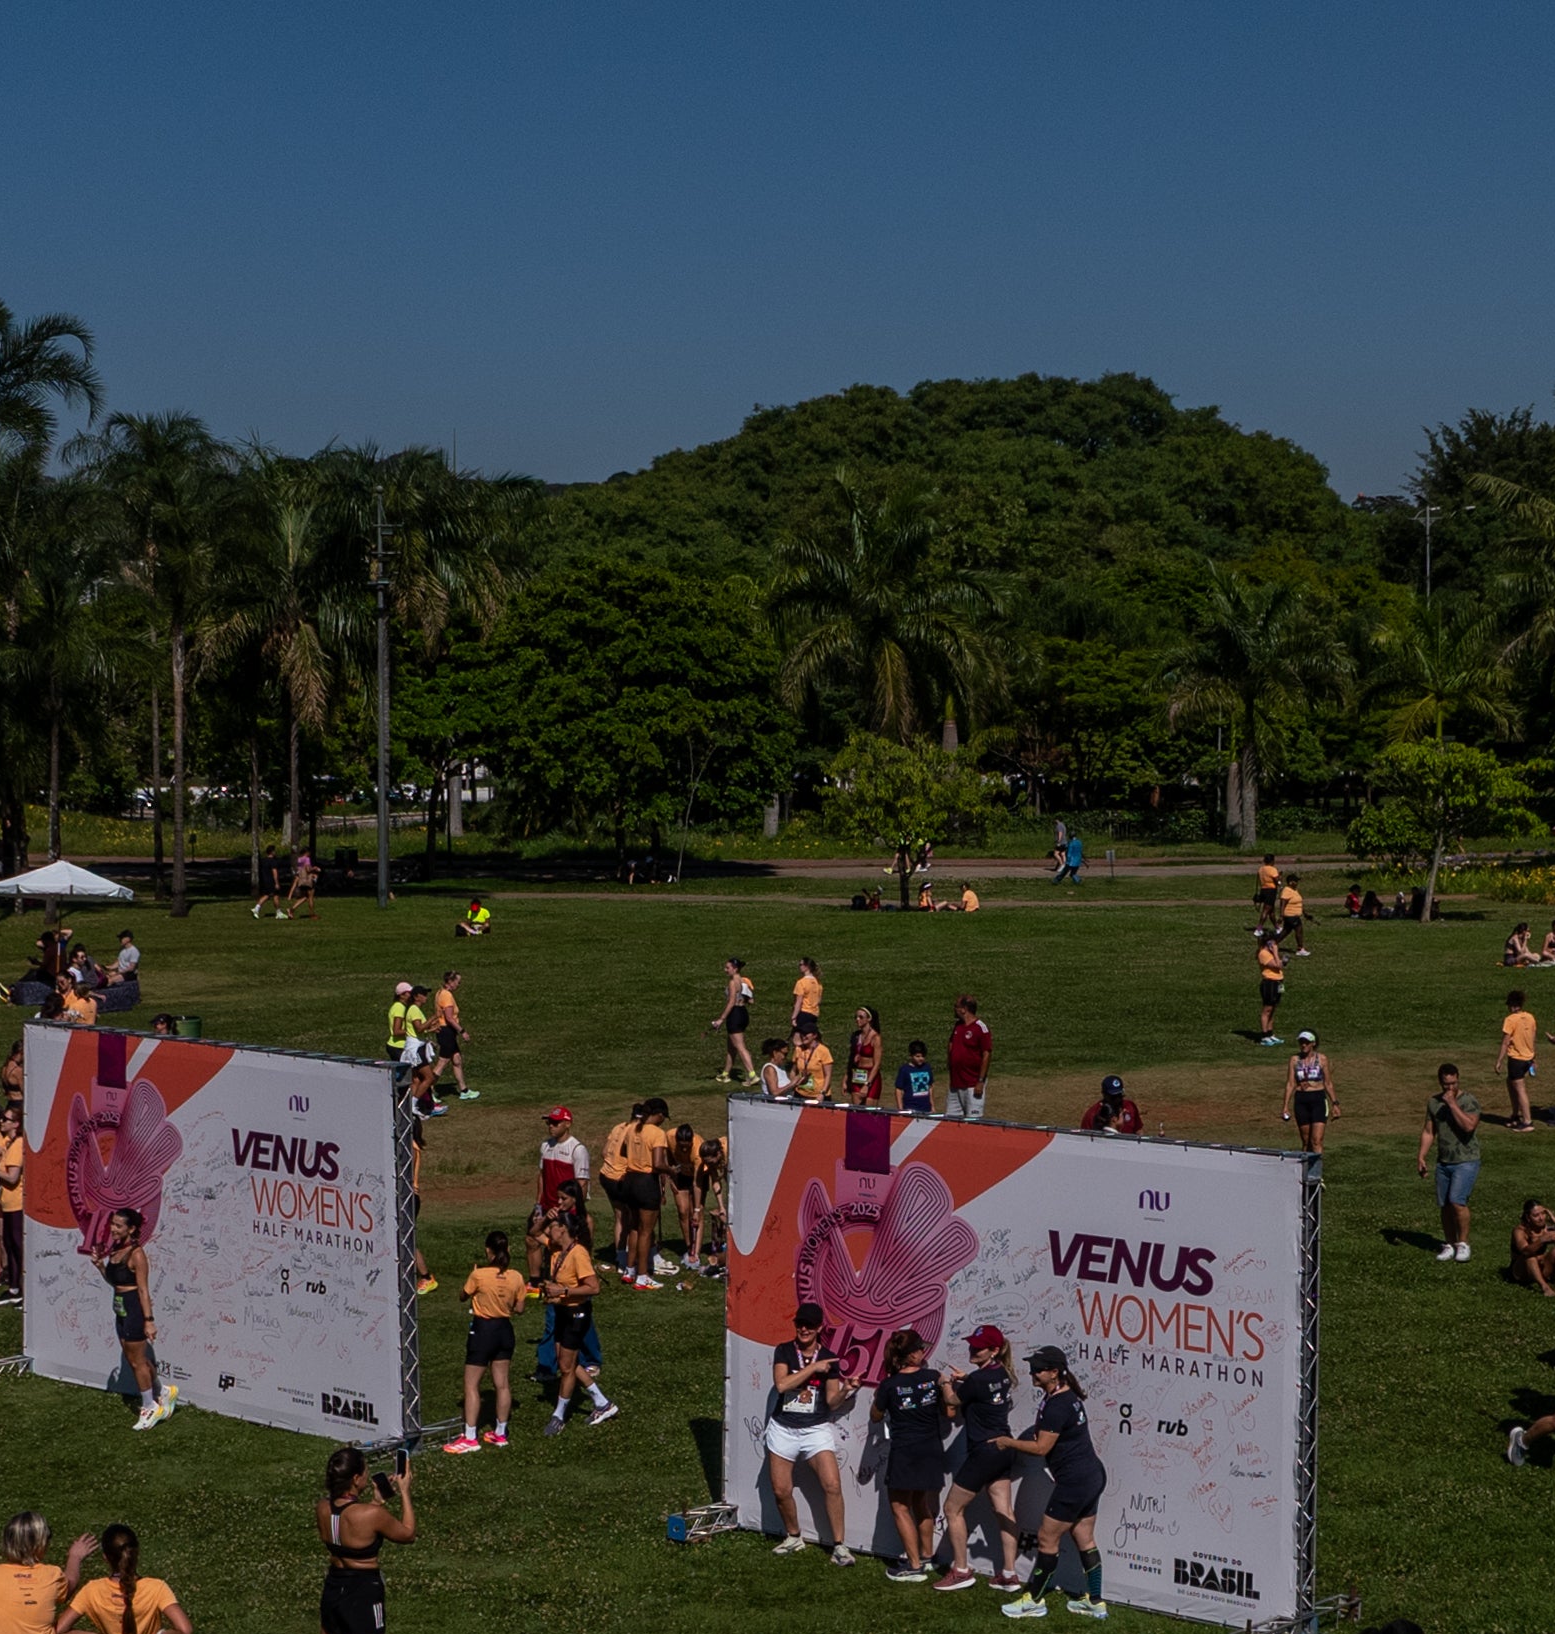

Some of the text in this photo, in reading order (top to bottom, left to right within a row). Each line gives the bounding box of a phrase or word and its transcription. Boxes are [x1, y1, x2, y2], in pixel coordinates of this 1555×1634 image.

[231, 1128, 341, 1181] VENUS
[250, 1175, 374, 1233] WOMEN'S
[850, 1201, 882, 1218] 2025
[1138, 1189, 1171, 1211] nu
[252, 1219, 374, 1254] HALF MARATHON
[1048, 1229, 1217, 1297] VENUS
[1076, 1288, 1265, 1361] WOMEN'S
[1078, 1343, 1264, 1388] HALF MARATHON
[321, 1393, 379, 1425] BRASIL
[1129, 1562, 1163, 1575] ESPORTE
[1192, 1551, 1229, 1564] GOVERNO
[1173, 1557, 1261, 1601] BRASIL
